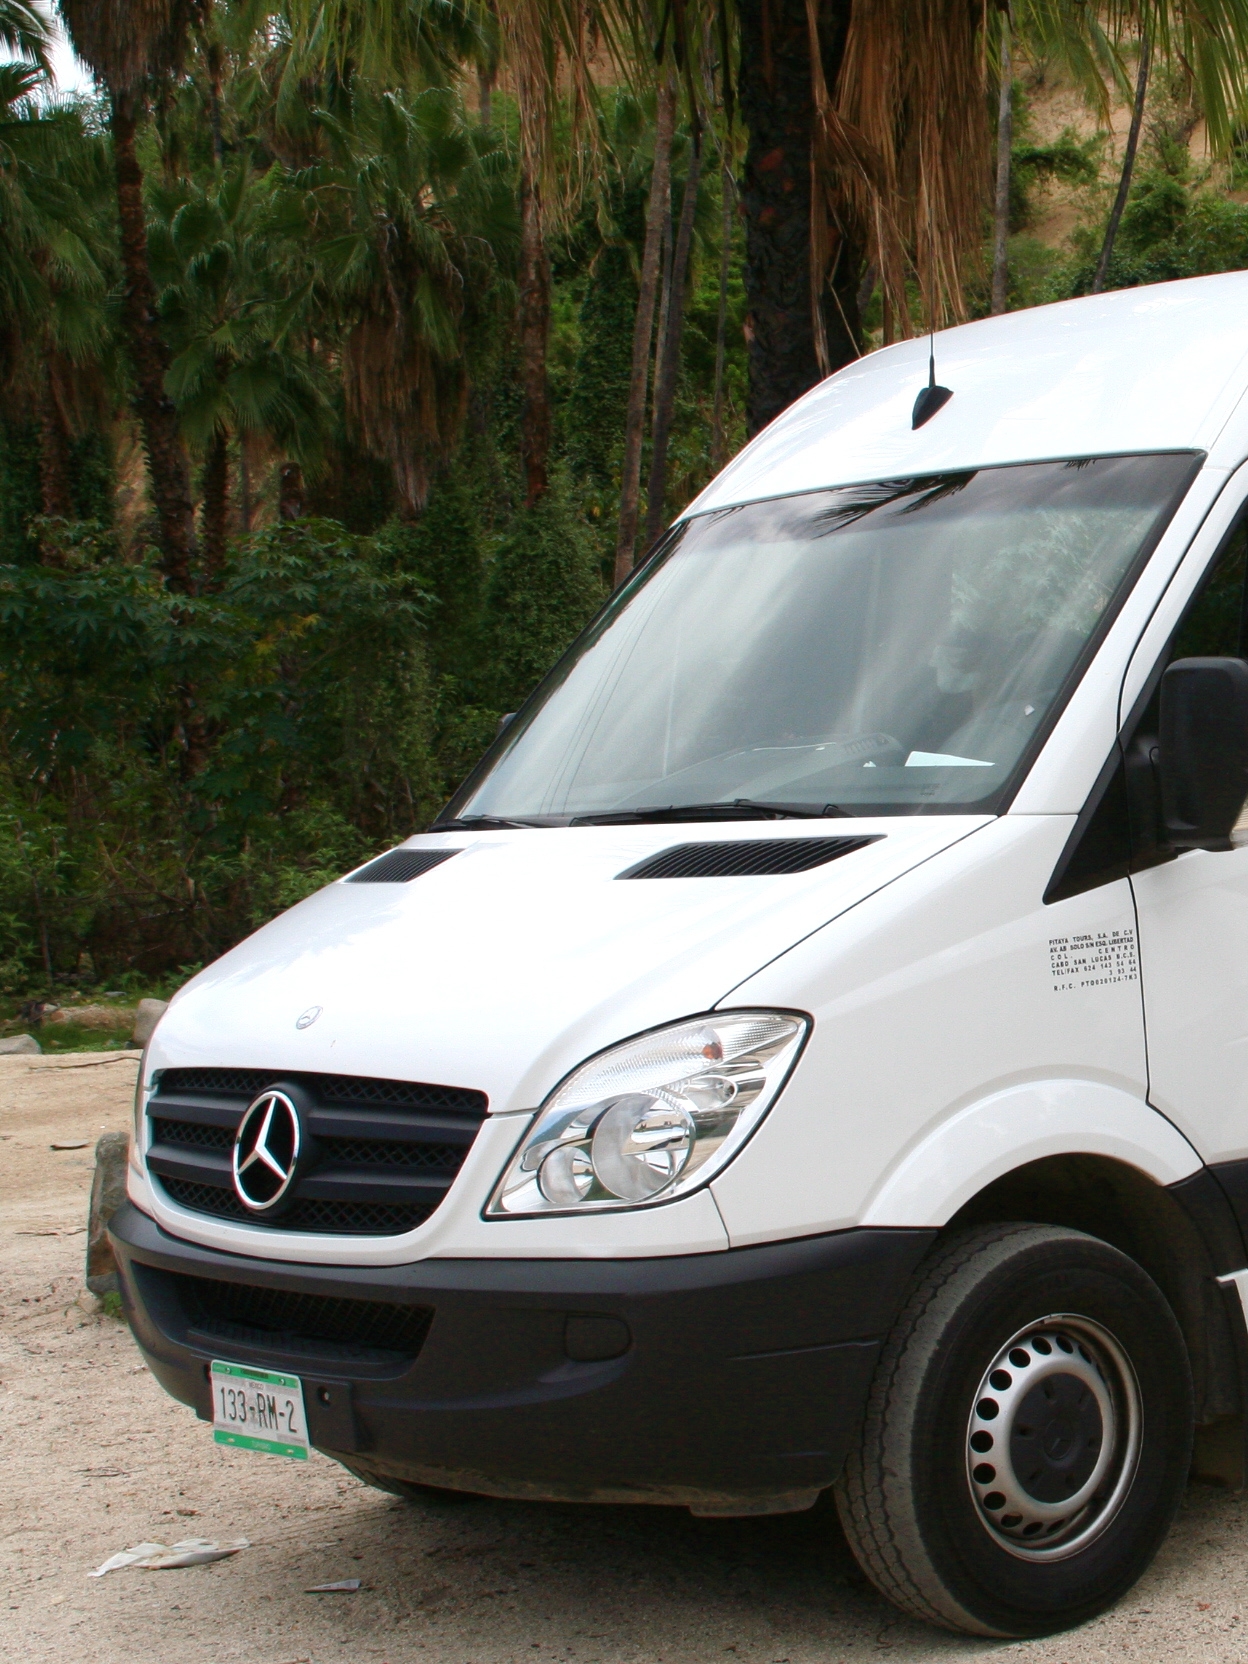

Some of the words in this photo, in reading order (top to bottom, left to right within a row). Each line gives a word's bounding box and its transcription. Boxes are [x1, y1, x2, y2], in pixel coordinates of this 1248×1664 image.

[1049, 938, 1069, 946] PITAYA
[1108, 937, 1134, 946] LIBERTAD
[1051, 960, 1069, 969] CABO
[1073, 958, 1087, 966] SAN
[1091, 954, 1112, 963] LUCAS
[1083, 964, 1096, 972] 624
[220, 1386, 298, 1433] 133-RM-2
